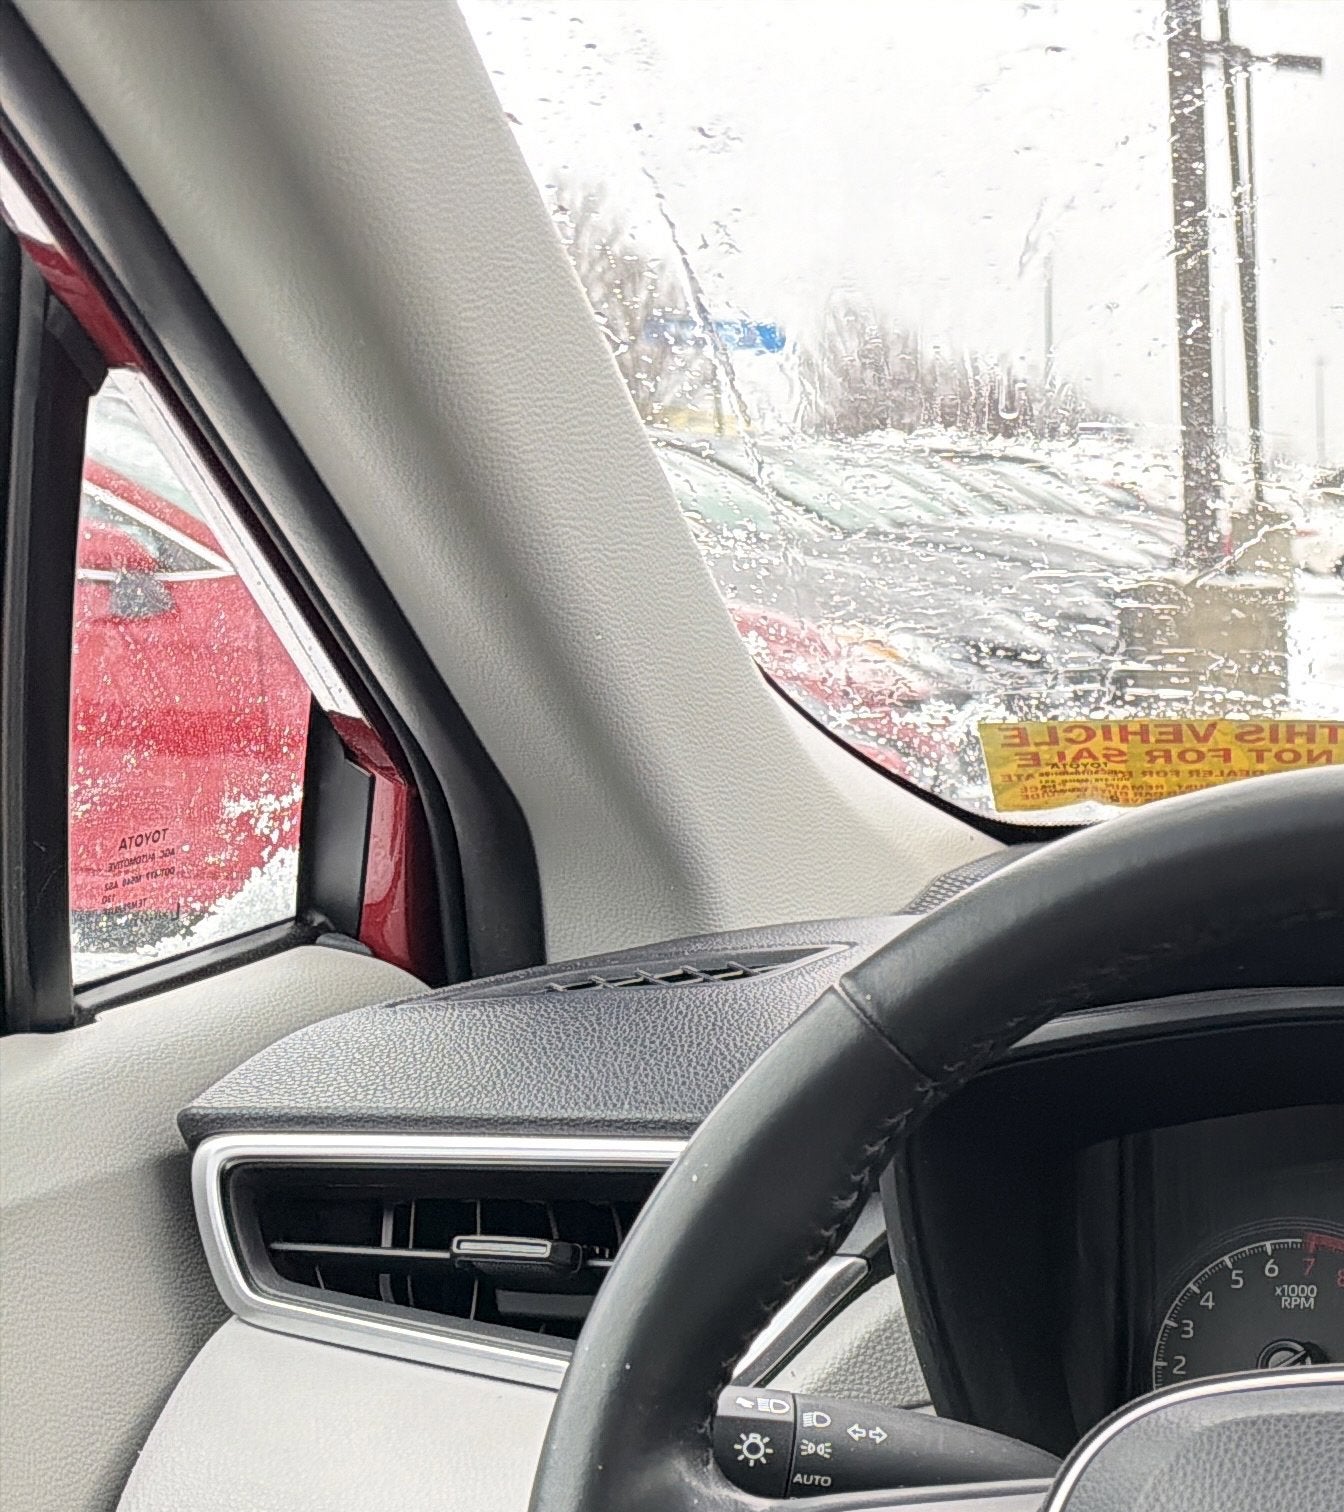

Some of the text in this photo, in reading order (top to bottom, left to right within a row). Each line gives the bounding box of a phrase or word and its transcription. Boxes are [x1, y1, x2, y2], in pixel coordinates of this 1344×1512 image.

[1264, 1259, 1280, 1278] 6
[1303, 1259, 1316, 1276] 7
[1230, 1270, 1244, 1289] 5
[1274, 1284, 1318, 1299] x1000
[1200, 1292, 1216, 1311] 4
[1280, 1296, 1315, 1310] RPM
[1180, 1319, 1195, 1339] 3
[1172, 1355, 1187, 1375] 2
[792, 1473, 833, 1488] AUTO
